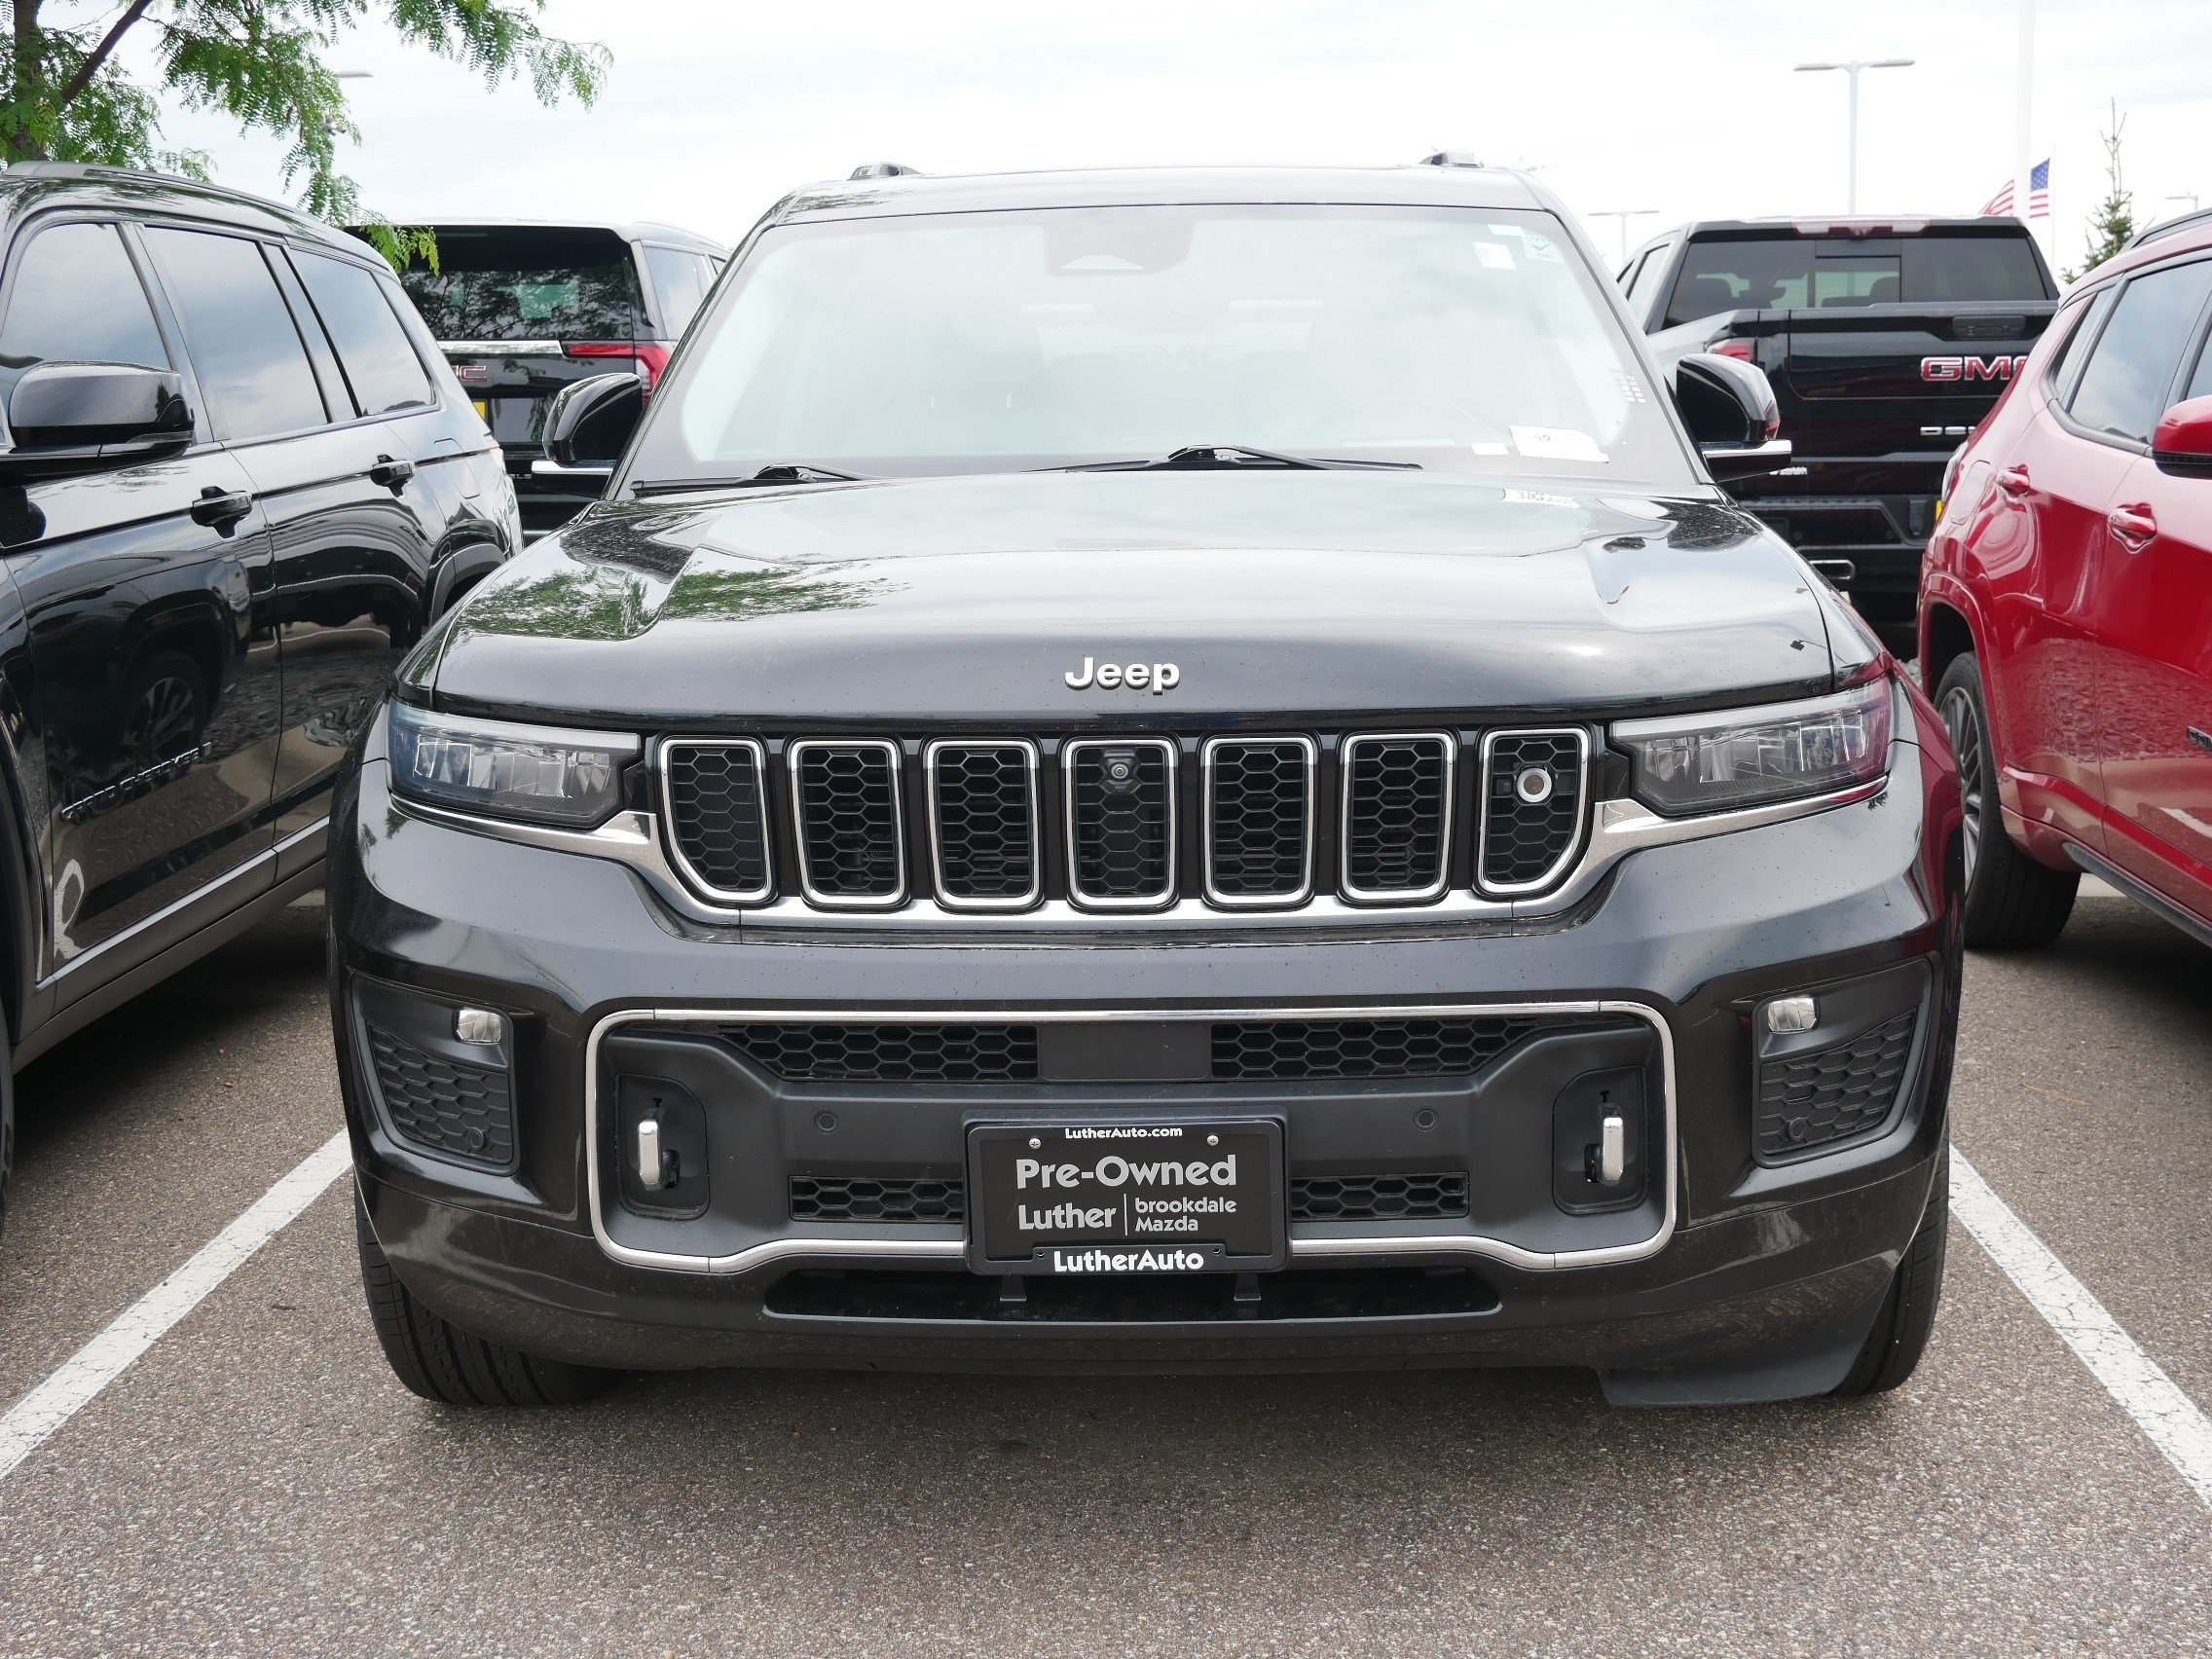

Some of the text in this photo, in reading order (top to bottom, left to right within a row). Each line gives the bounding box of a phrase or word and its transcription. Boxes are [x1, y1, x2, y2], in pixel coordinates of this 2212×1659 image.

[451, 364, 488, 382] C
[1064, 656, 1181, 695] Jeep
[1064, 1126, 1183, 1139] LutherAuto.com
[1015, 1154, 1237, 1190] Pre-Owned
[1134, 1196, 1237, 1214] brookdale
[1017, 1202, 1118, 1231] Luther
[1134, 1215, 1199, 1233] Mazda
[1053, 1248, 1205, 1272] LutherAuto
